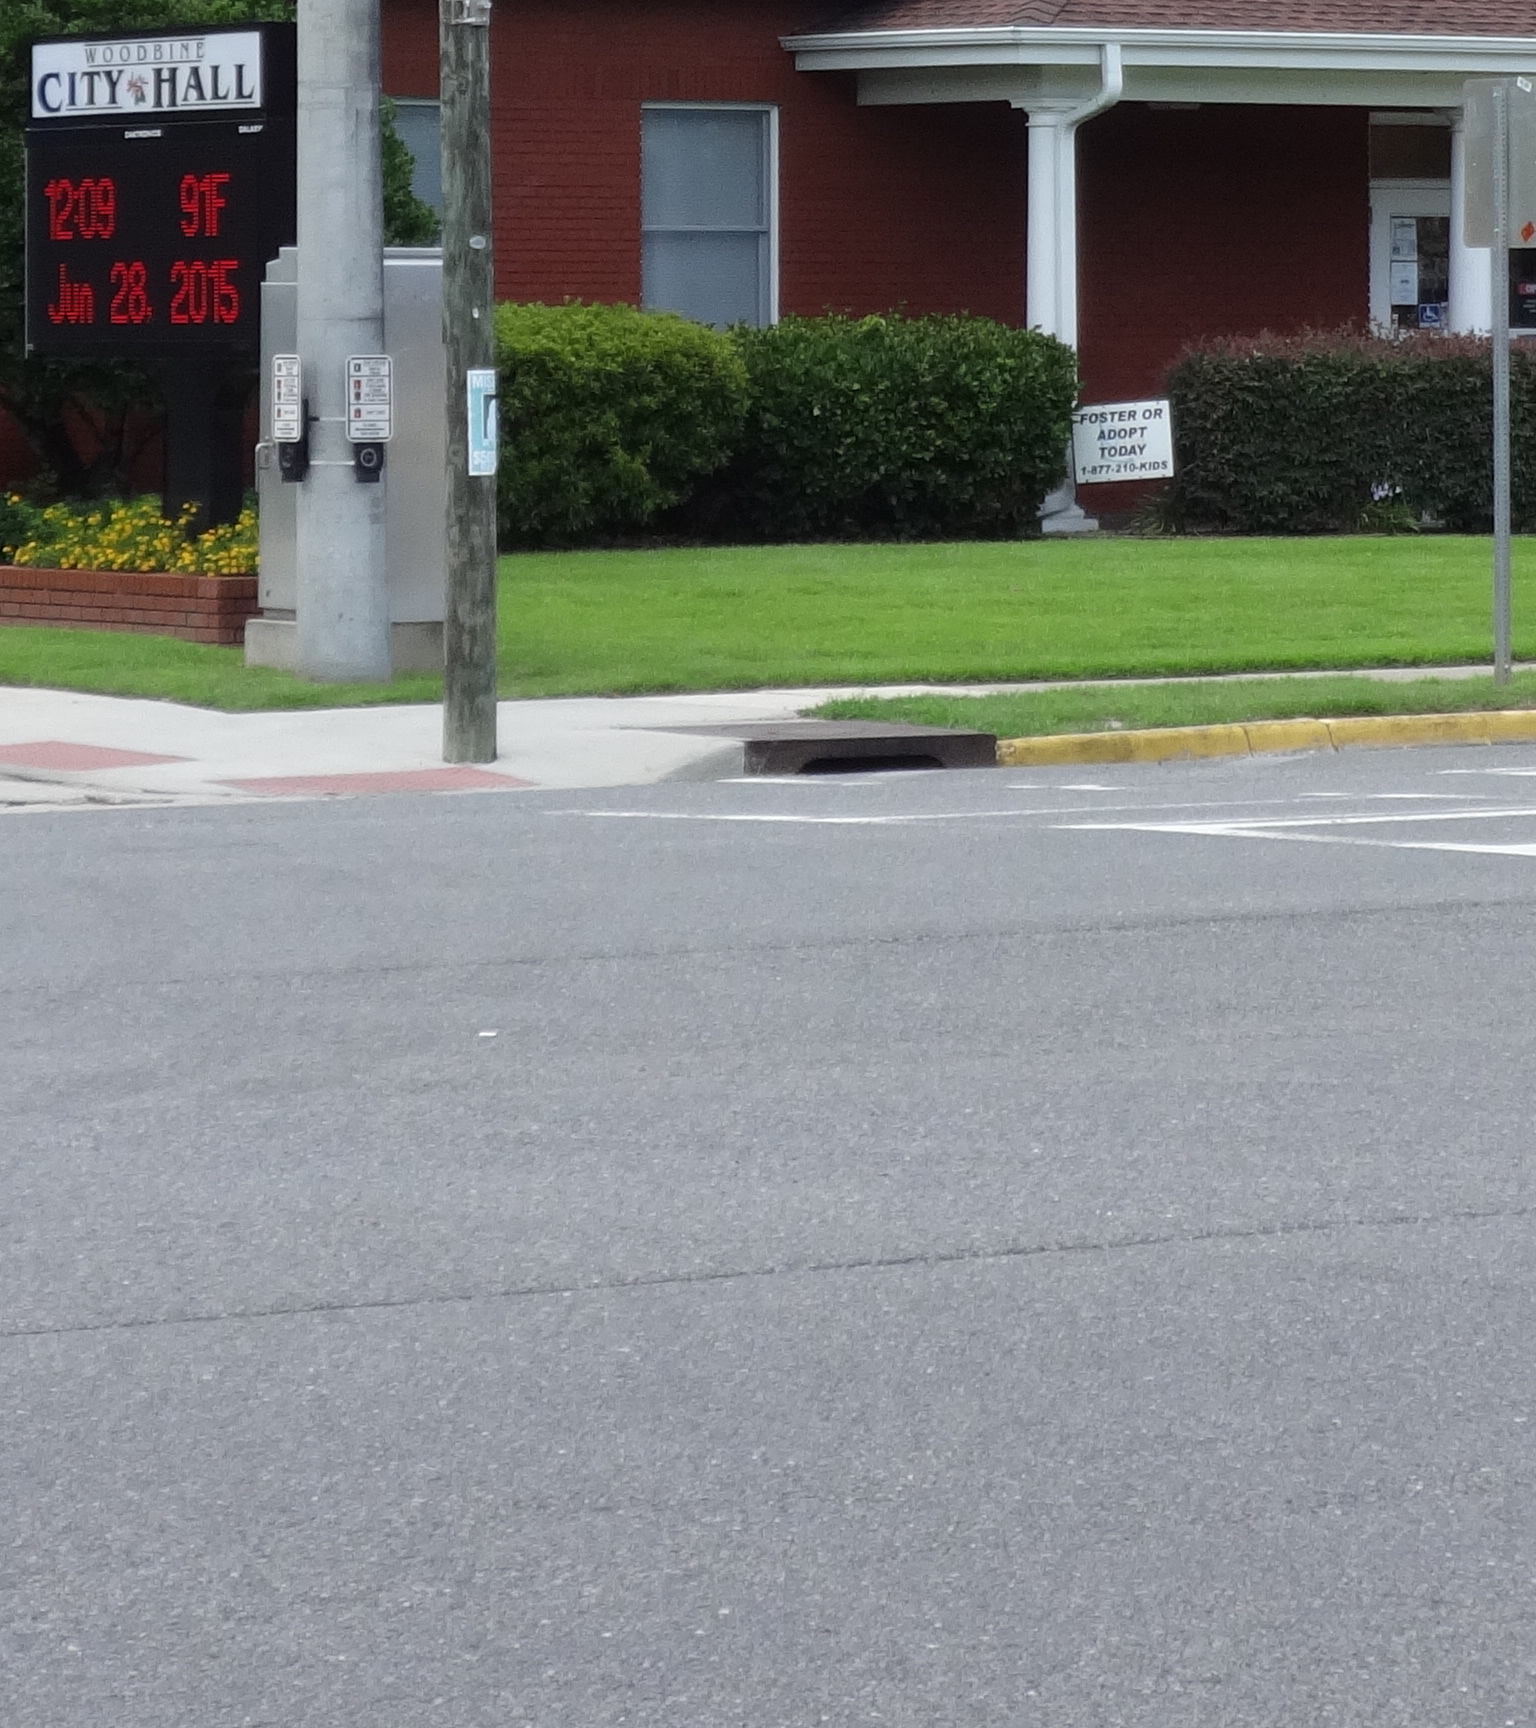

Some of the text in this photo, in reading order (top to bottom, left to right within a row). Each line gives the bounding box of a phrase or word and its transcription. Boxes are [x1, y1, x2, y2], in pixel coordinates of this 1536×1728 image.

[84, 41, 205, 63] WOODBINE
[37, 63, 256, 113] CITY HALL
[48, 263, 94, 324] Jun
[170, 260, 240, 324] 2015
[472, 374, 496, 389] MIS
[1080, 408, 1163, 425] FOSTER OR
[1097, 426, 1148, 441] ADOPT
[1099, 444, 1147, 459] TODAY
[1080, 460, 1168, 475] 1-877-210-KIDS
